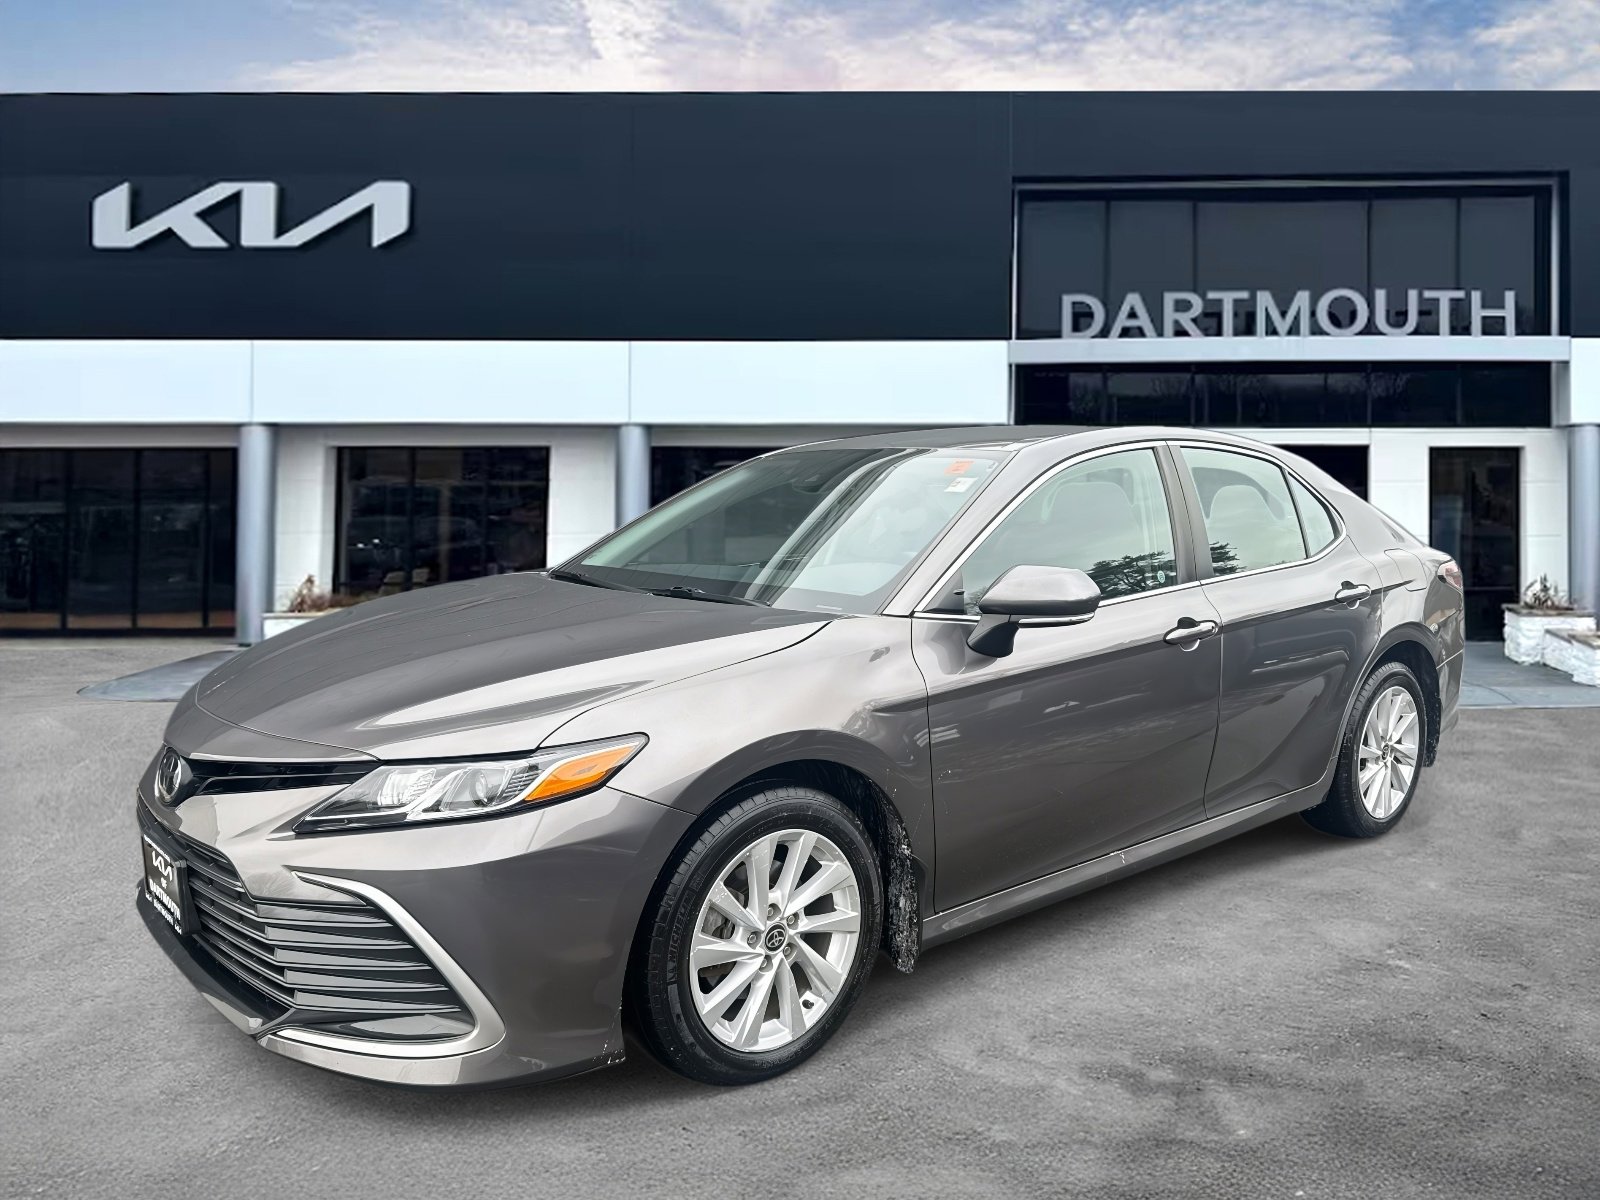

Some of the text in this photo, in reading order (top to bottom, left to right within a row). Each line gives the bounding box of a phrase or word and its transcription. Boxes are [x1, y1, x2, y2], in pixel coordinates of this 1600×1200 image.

[92, 180, 410, 248] KIA
[1061, 288, 1517, 338] DARTMOUTH
[149, 878, 181, 920] DARTMOUTH
